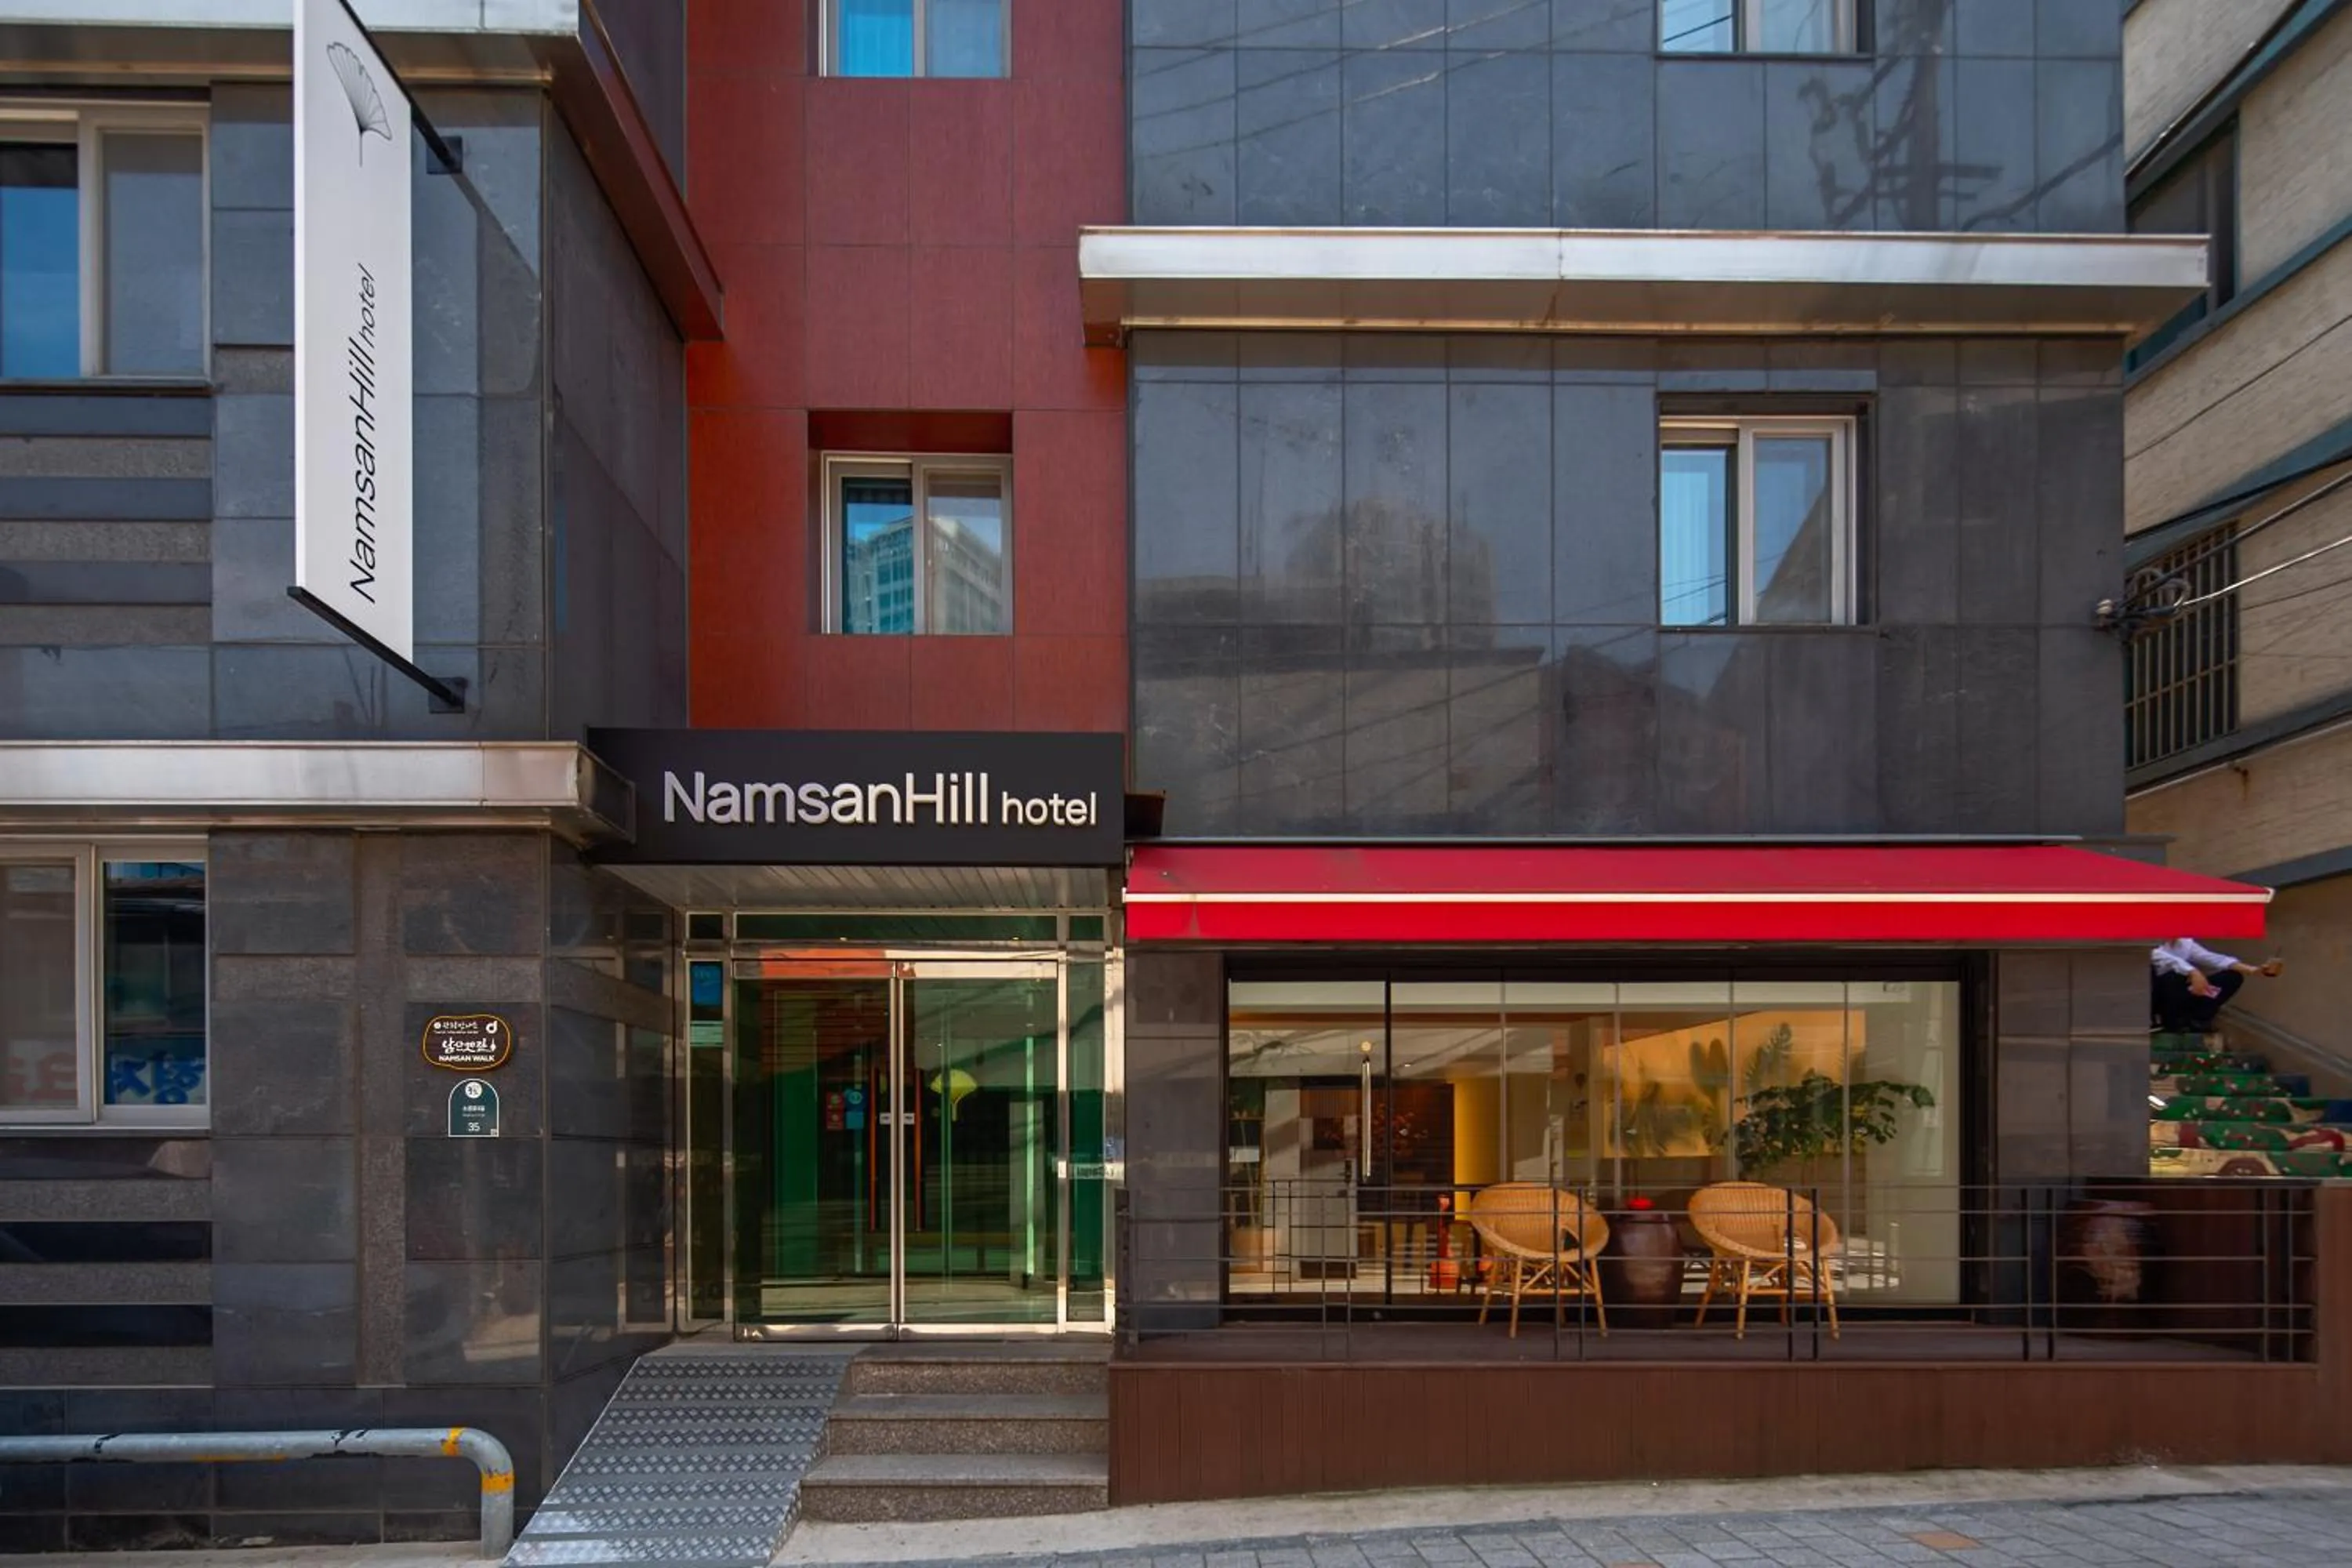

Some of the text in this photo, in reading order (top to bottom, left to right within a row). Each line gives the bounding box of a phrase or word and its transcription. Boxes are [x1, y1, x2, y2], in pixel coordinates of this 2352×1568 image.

[349, 263, 376, 604] NamsanHill hotel
[663, 770, 1097, 826] NamsanHill hotel
[467, 1122, 481, 1132] 35
